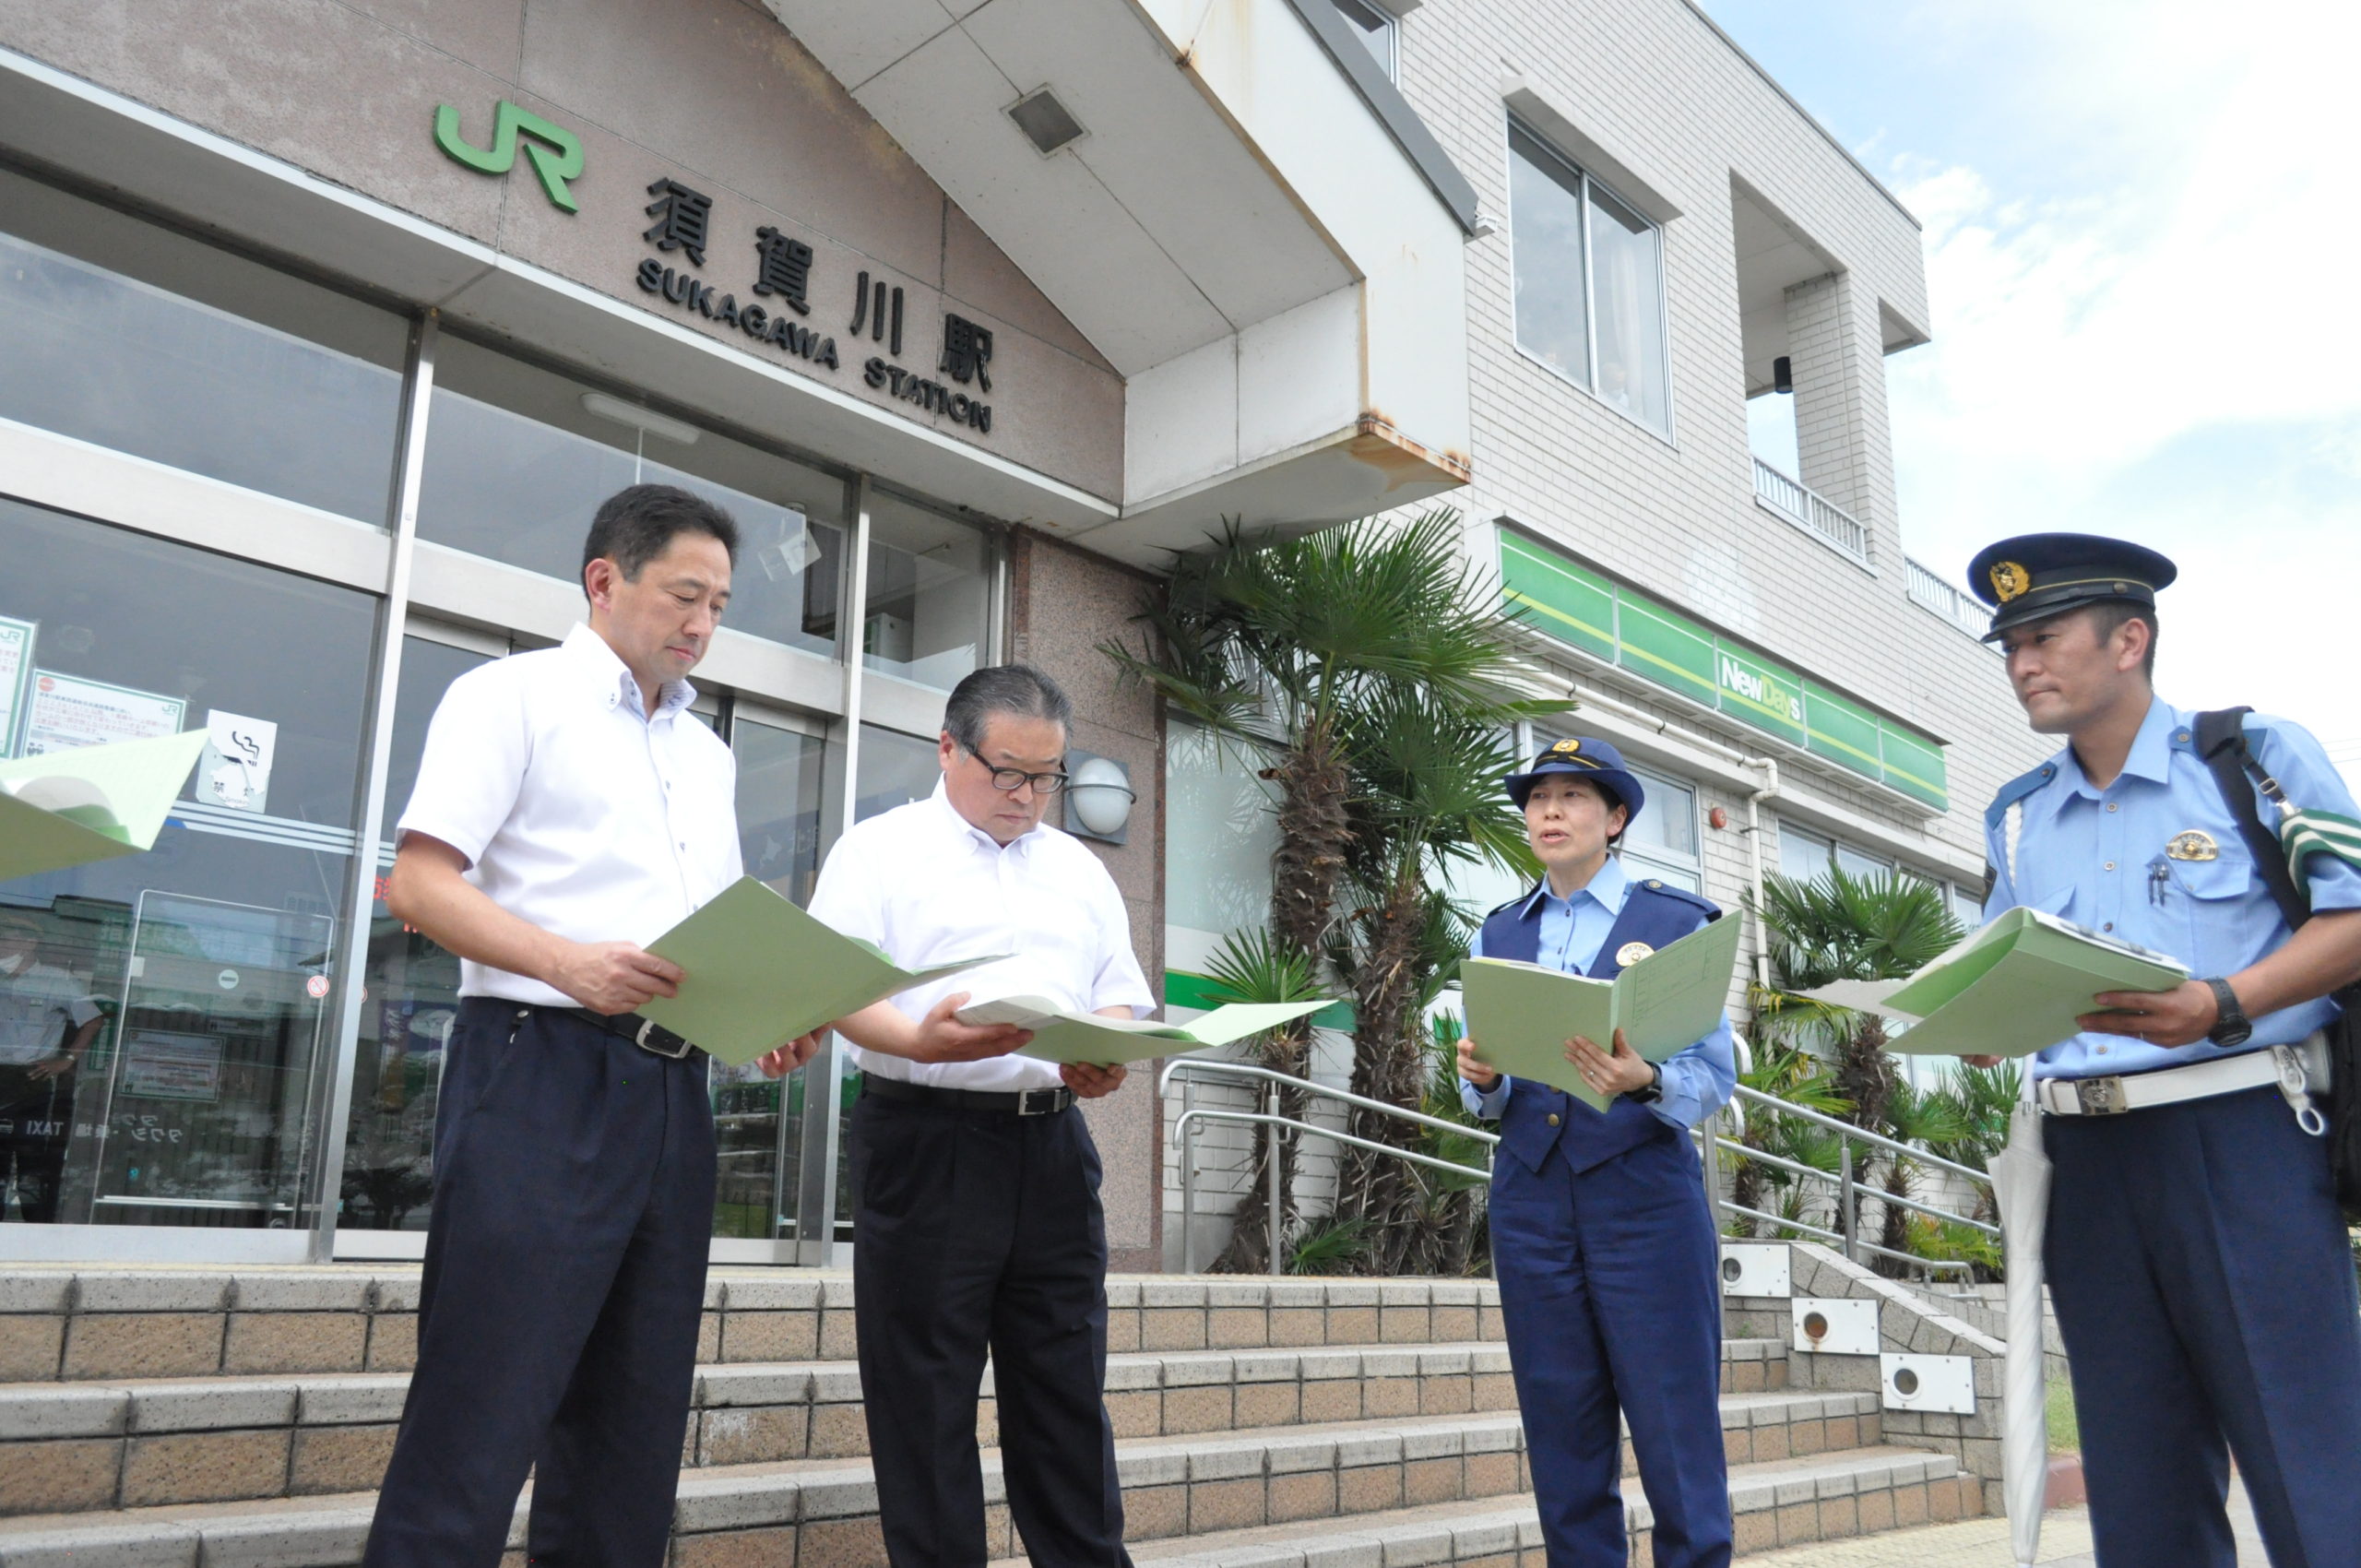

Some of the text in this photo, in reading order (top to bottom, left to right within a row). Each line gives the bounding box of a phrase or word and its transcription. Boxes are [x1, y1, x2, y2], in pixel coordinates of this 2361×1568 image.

[434, 101, 585, 214] JR
[636, 257, 991, 433] SUKAGAWA STATION
[643, 177, 993, 393] 須賀川駅
[1722, 656, 1801, 721] NewDays
